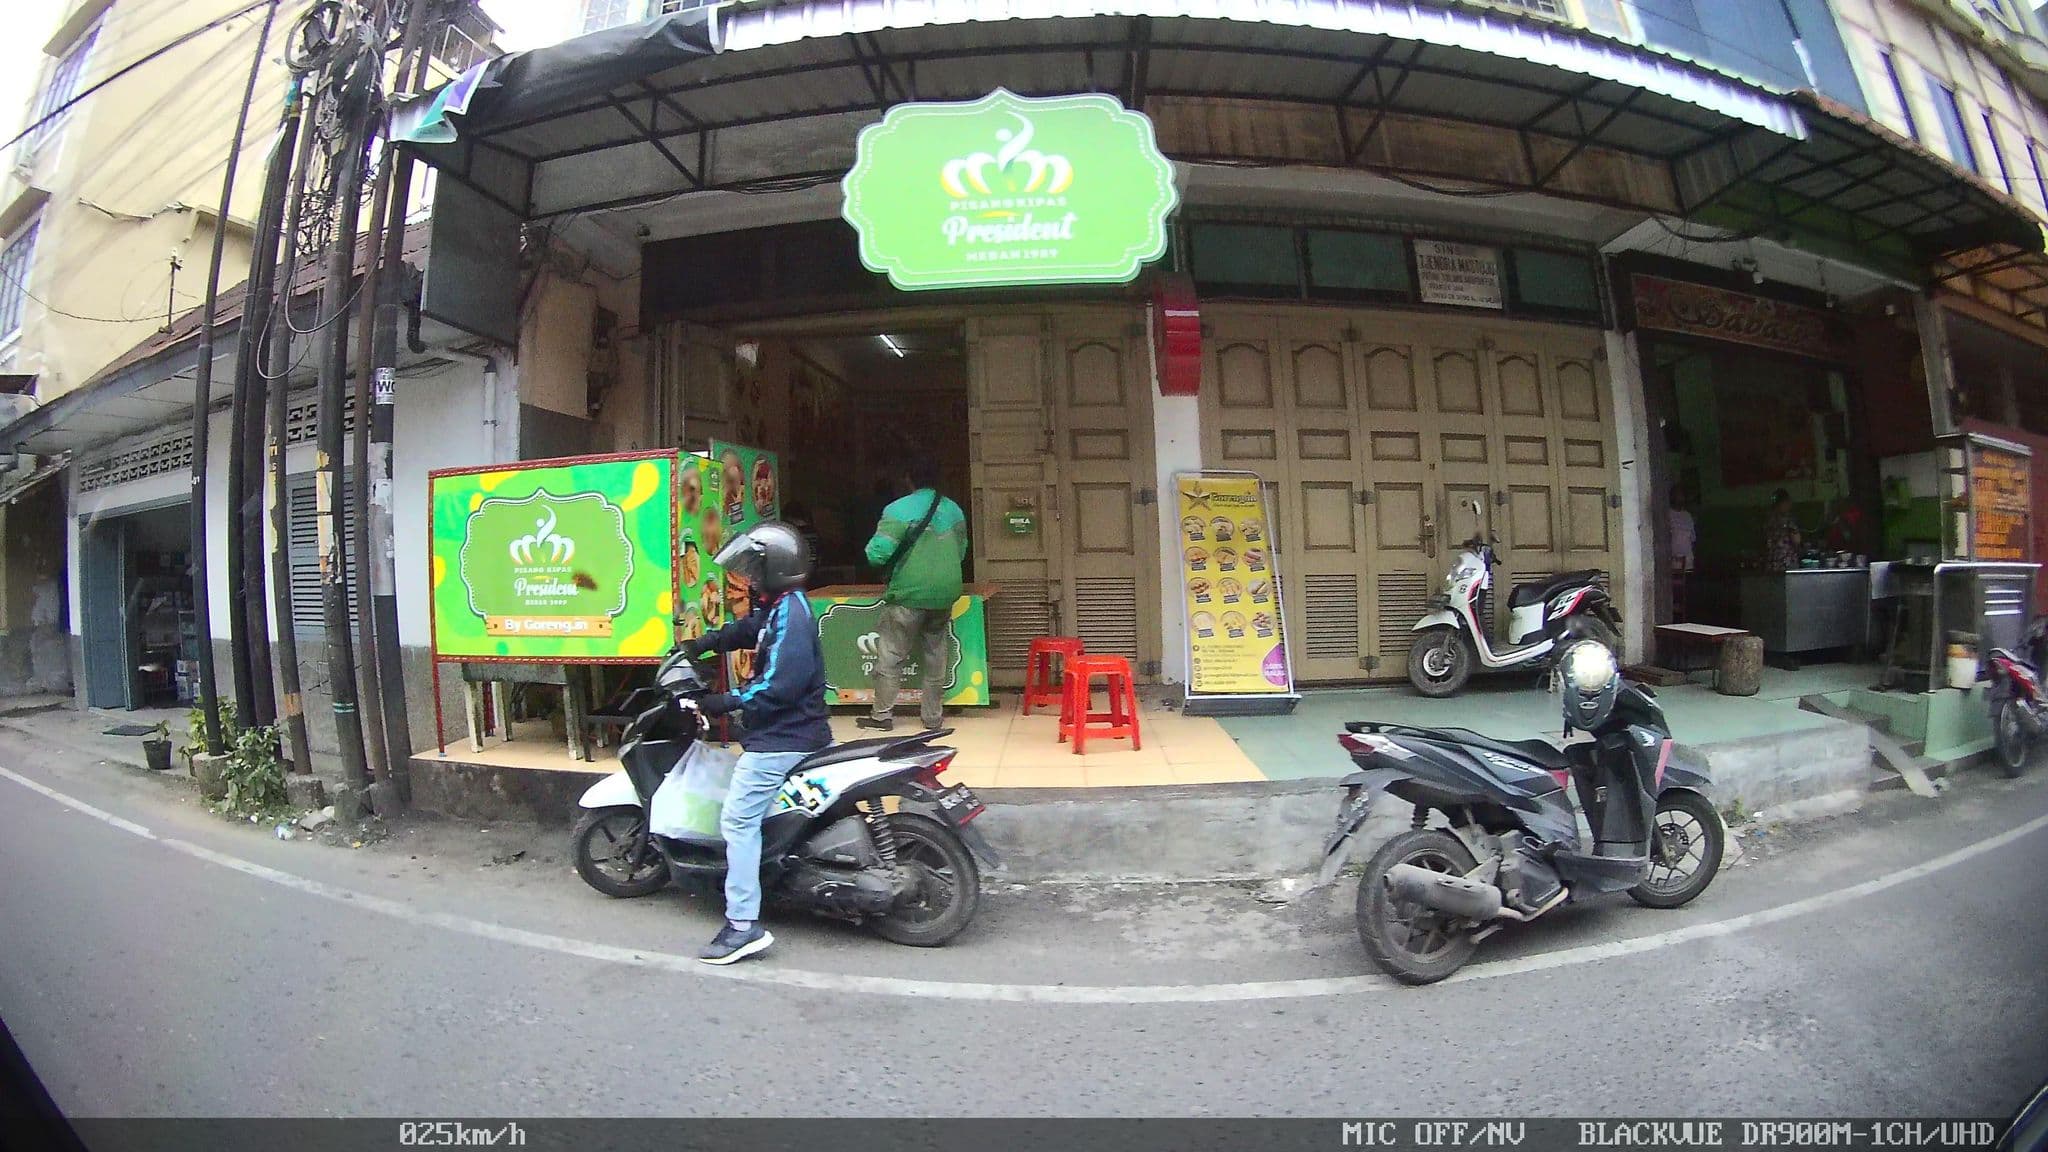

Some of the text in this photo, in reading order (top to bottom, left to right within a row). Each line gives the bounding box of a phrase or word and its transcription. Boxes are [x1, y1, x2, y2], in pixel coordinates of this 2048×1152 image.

[949, 196, 1068, 211] PISANG KIPAS
[941, 212, 1079, 247] President
[513, 566, 545, 574] PISANG
[513, 577, 580, 597] Presiden
[504, 618, 521, 634] By
